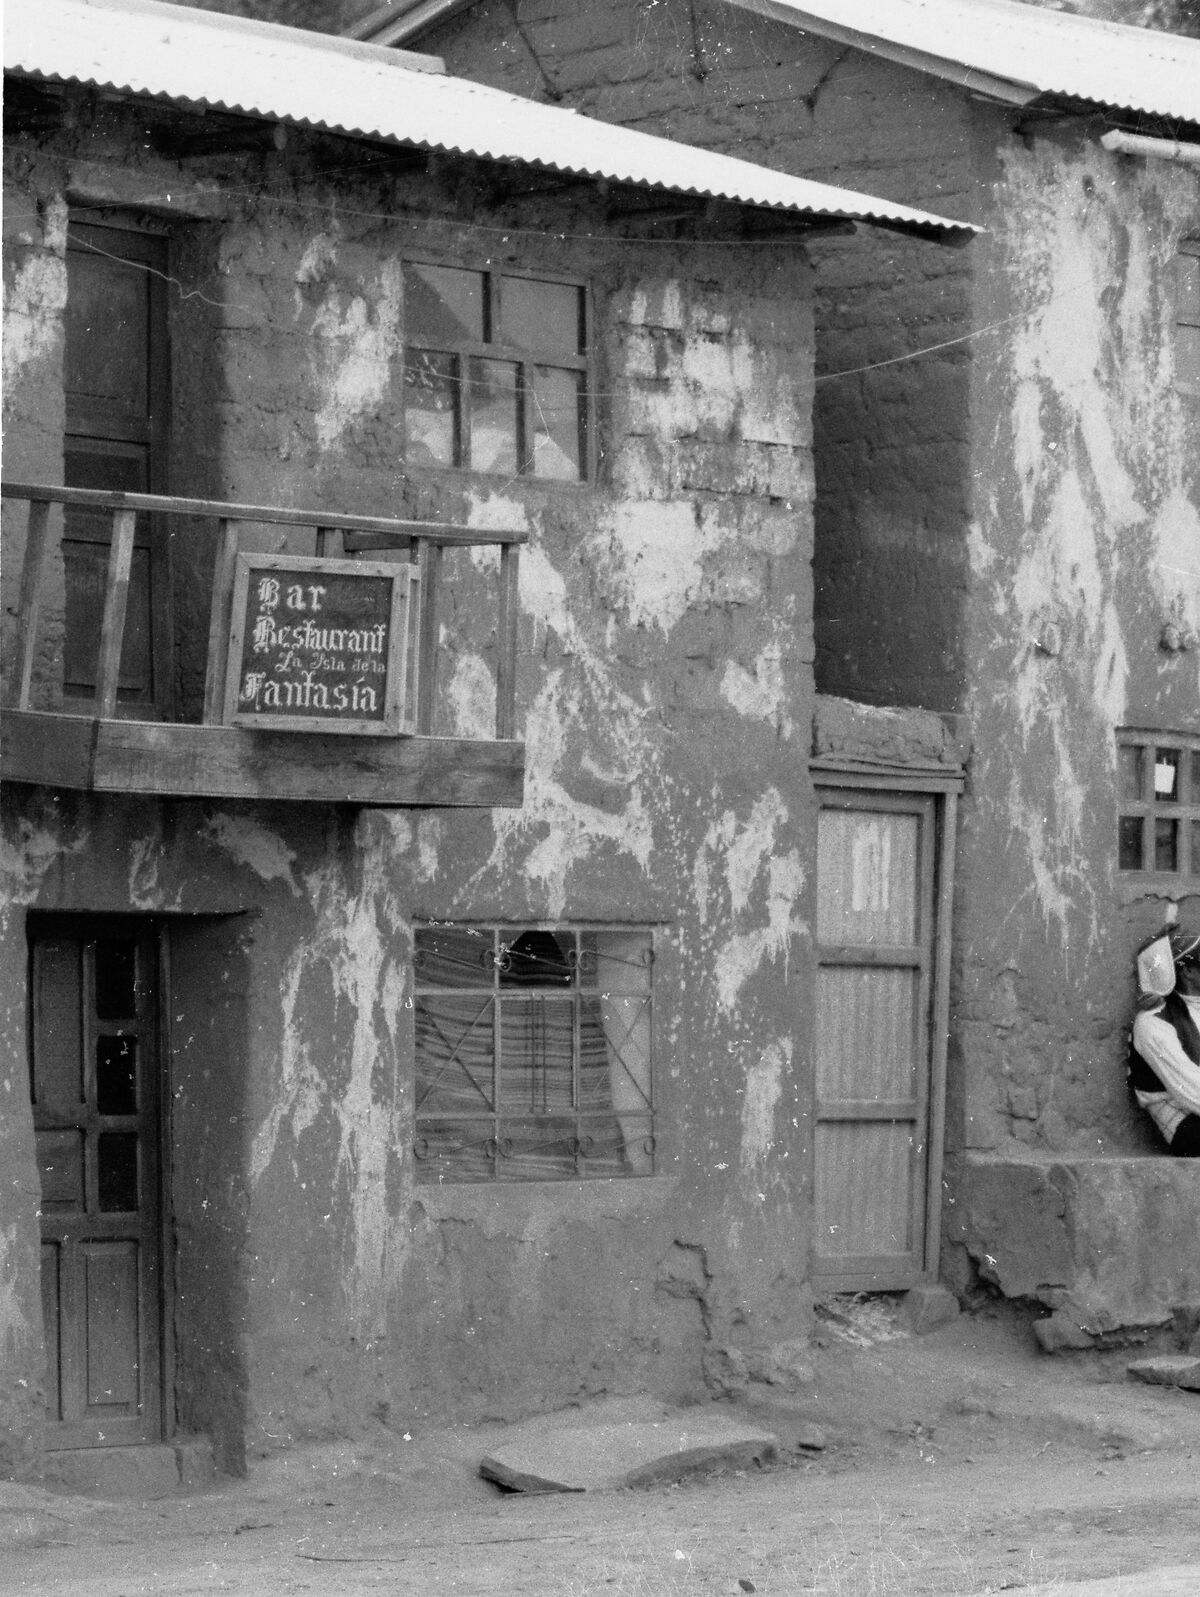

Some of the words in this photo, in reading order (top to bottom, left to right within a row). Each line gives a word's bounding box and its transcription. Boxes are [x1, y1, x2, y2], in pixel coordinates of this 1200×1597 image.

[258, 577, 327, 614] Bar
[252, 616, 386, 653] Restaurant
[240, 670, 378, 712] Fantasía
